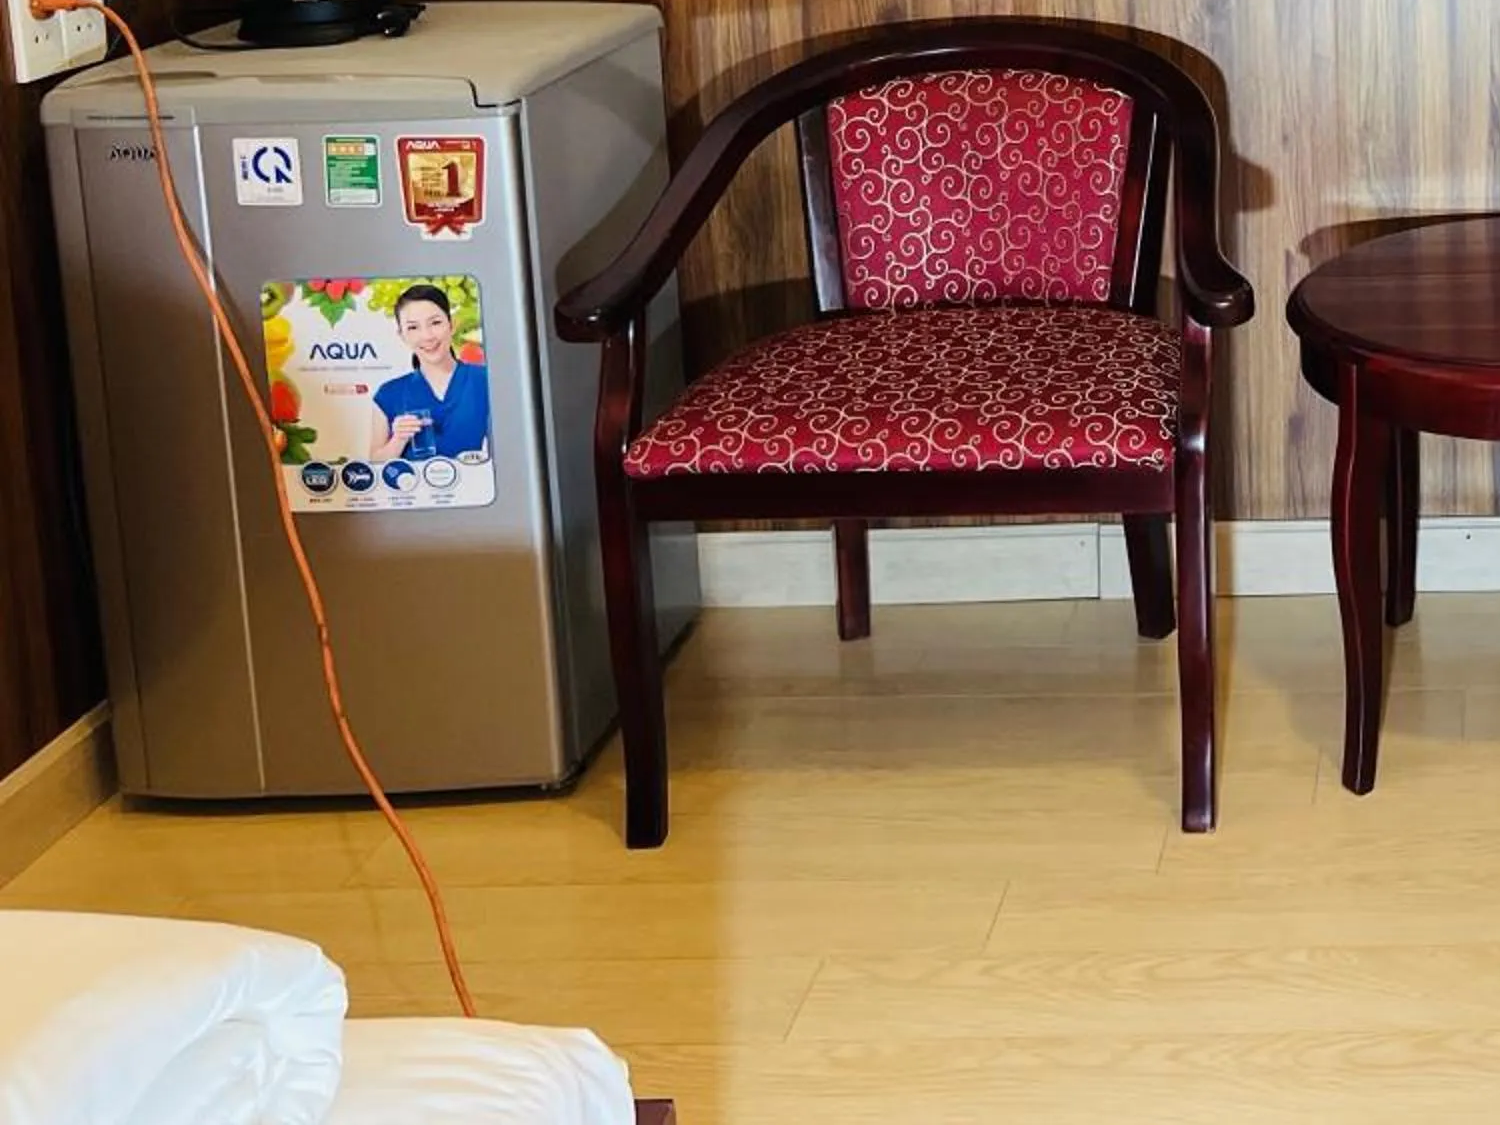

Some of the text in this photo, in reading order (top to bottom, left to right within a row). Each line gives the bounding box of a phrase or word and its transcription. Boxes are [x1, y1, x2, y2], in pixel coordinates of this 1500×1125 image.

[406, 140, 440, 150] AQUA
[442, 161, 461, 197] 1
[309, 342, 378, 360] AQUA
